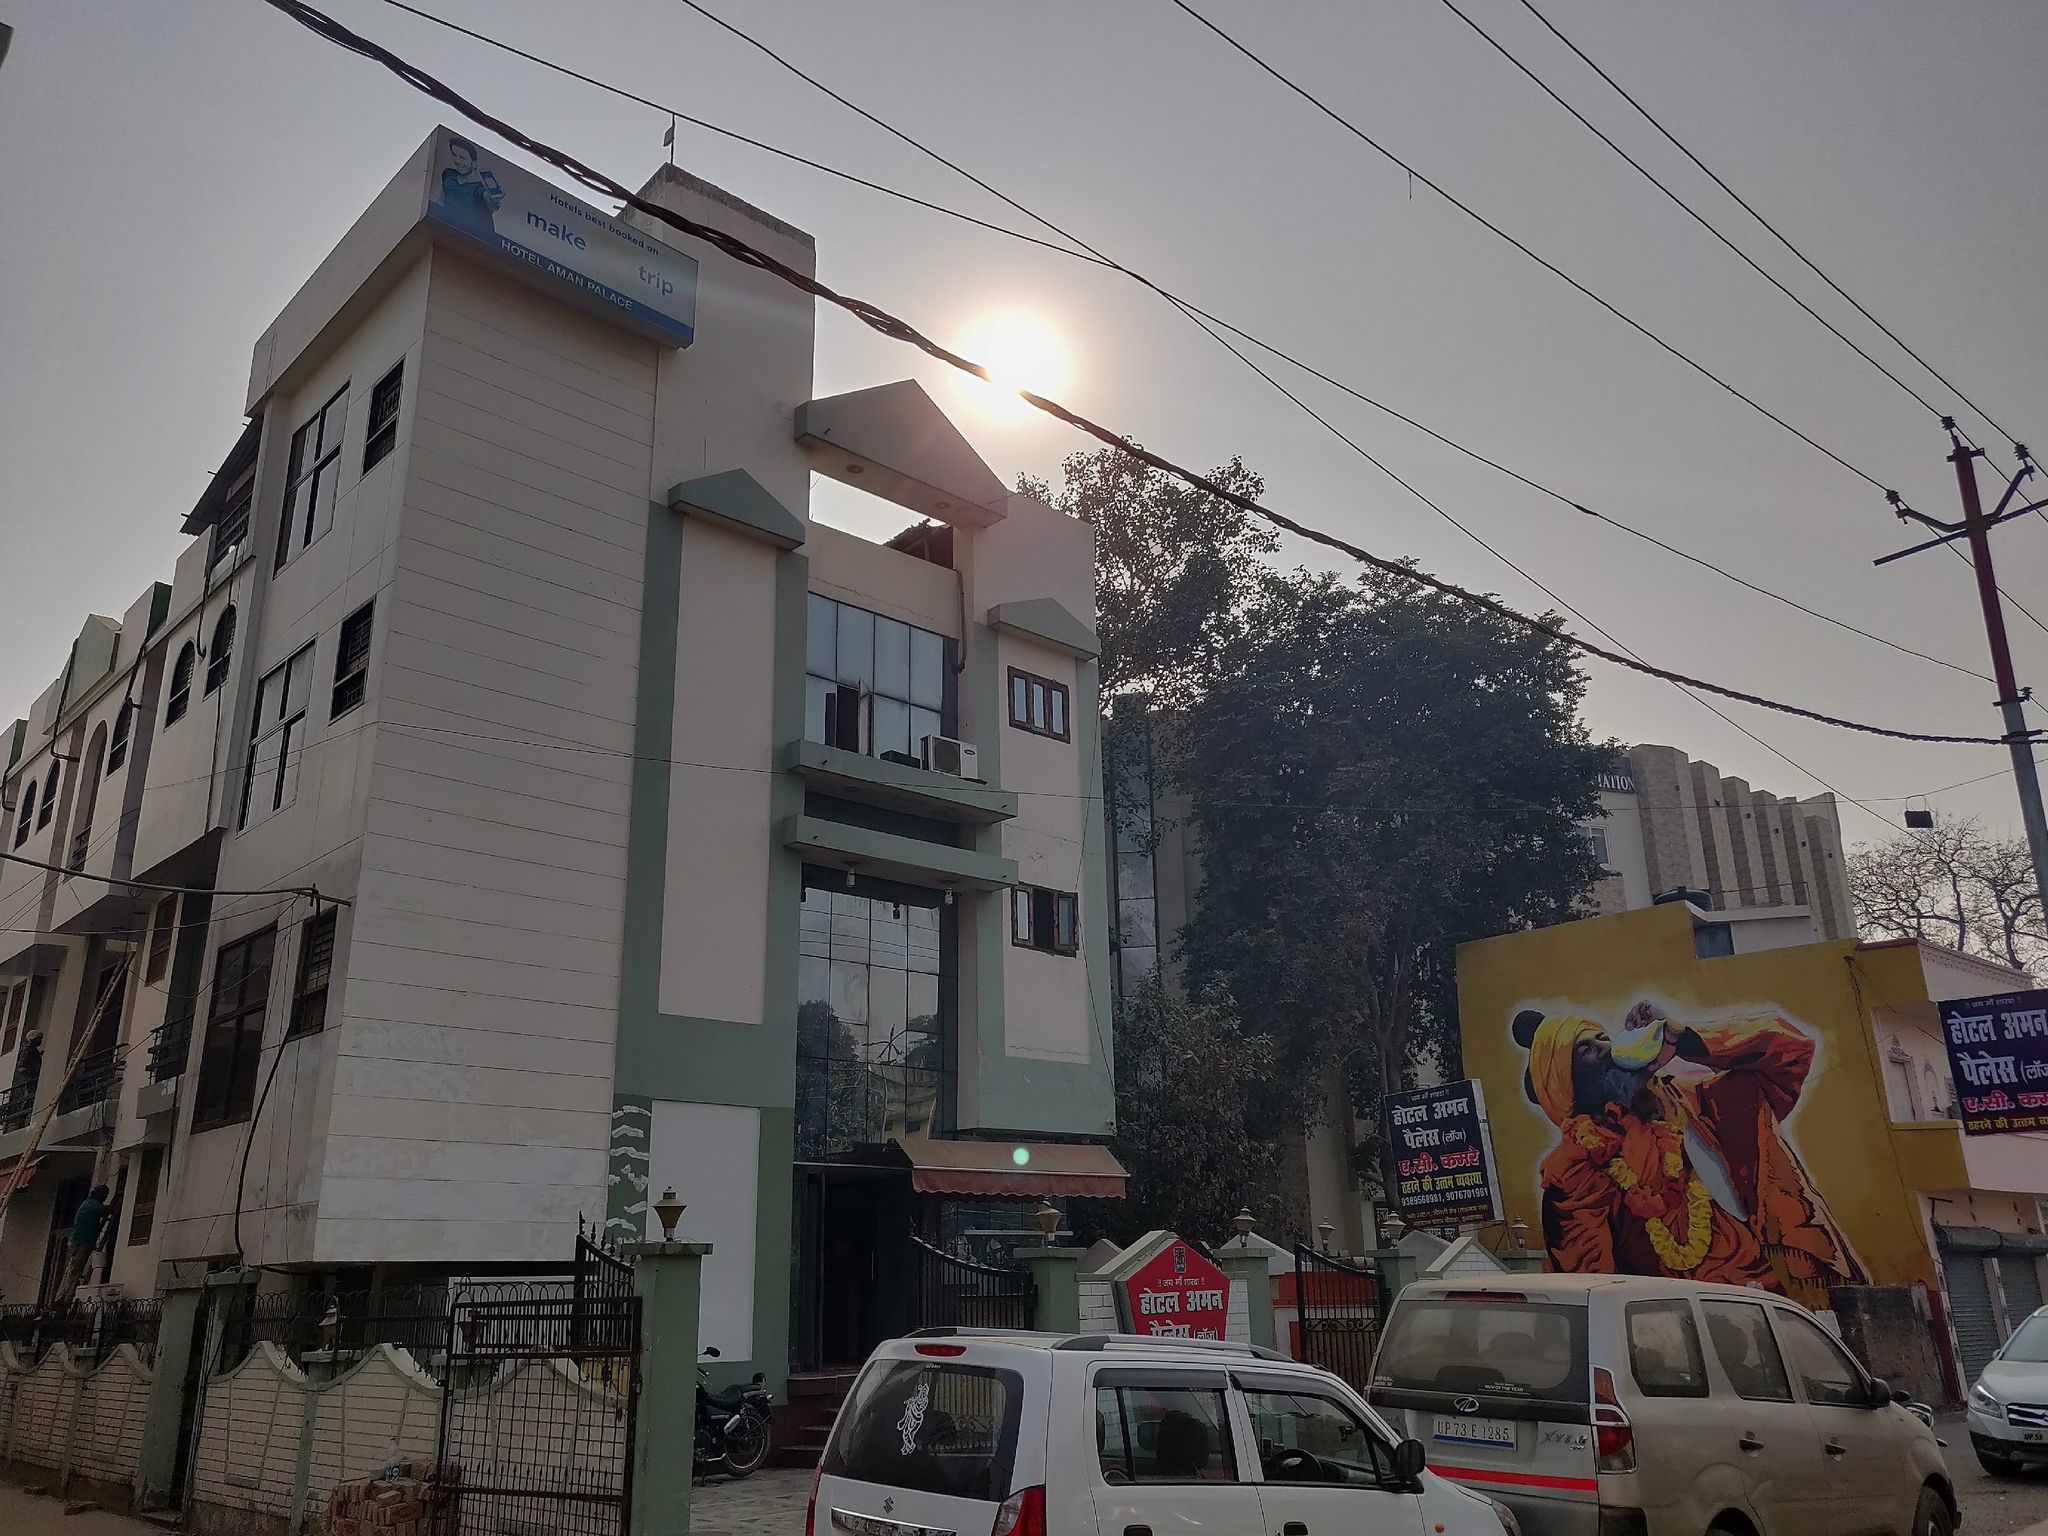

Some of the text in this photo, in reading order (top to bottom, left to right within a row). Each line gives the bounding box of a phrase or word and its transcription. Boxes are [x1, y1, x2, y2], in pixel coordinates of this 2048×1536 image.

[549, 193, 659, 256] Hotels best booked on
[526, 210, 674, 296] make trip
[500, 239, 634, 311] HOTEL AMAN PALACE
[1947, 1009, 2048, 1045] होटल अमन
[1956, 1050, 2018, 1086] पैलेस
[1391, 1097, 1470, 1126] होटल अमन
[1962, 1089, 2016, 1113] ए.सी.
[1401, 1126, 1467, 1149] पैलेस (लॉज)
[1440, 1145, 1480, 1170] कमरे
[1421, 1173, 1433, 1192] की
[1139, 1287, 1224, 1315] होटल अमन
[1437, 1420, 1510, 1441] UP 73 E 1285
